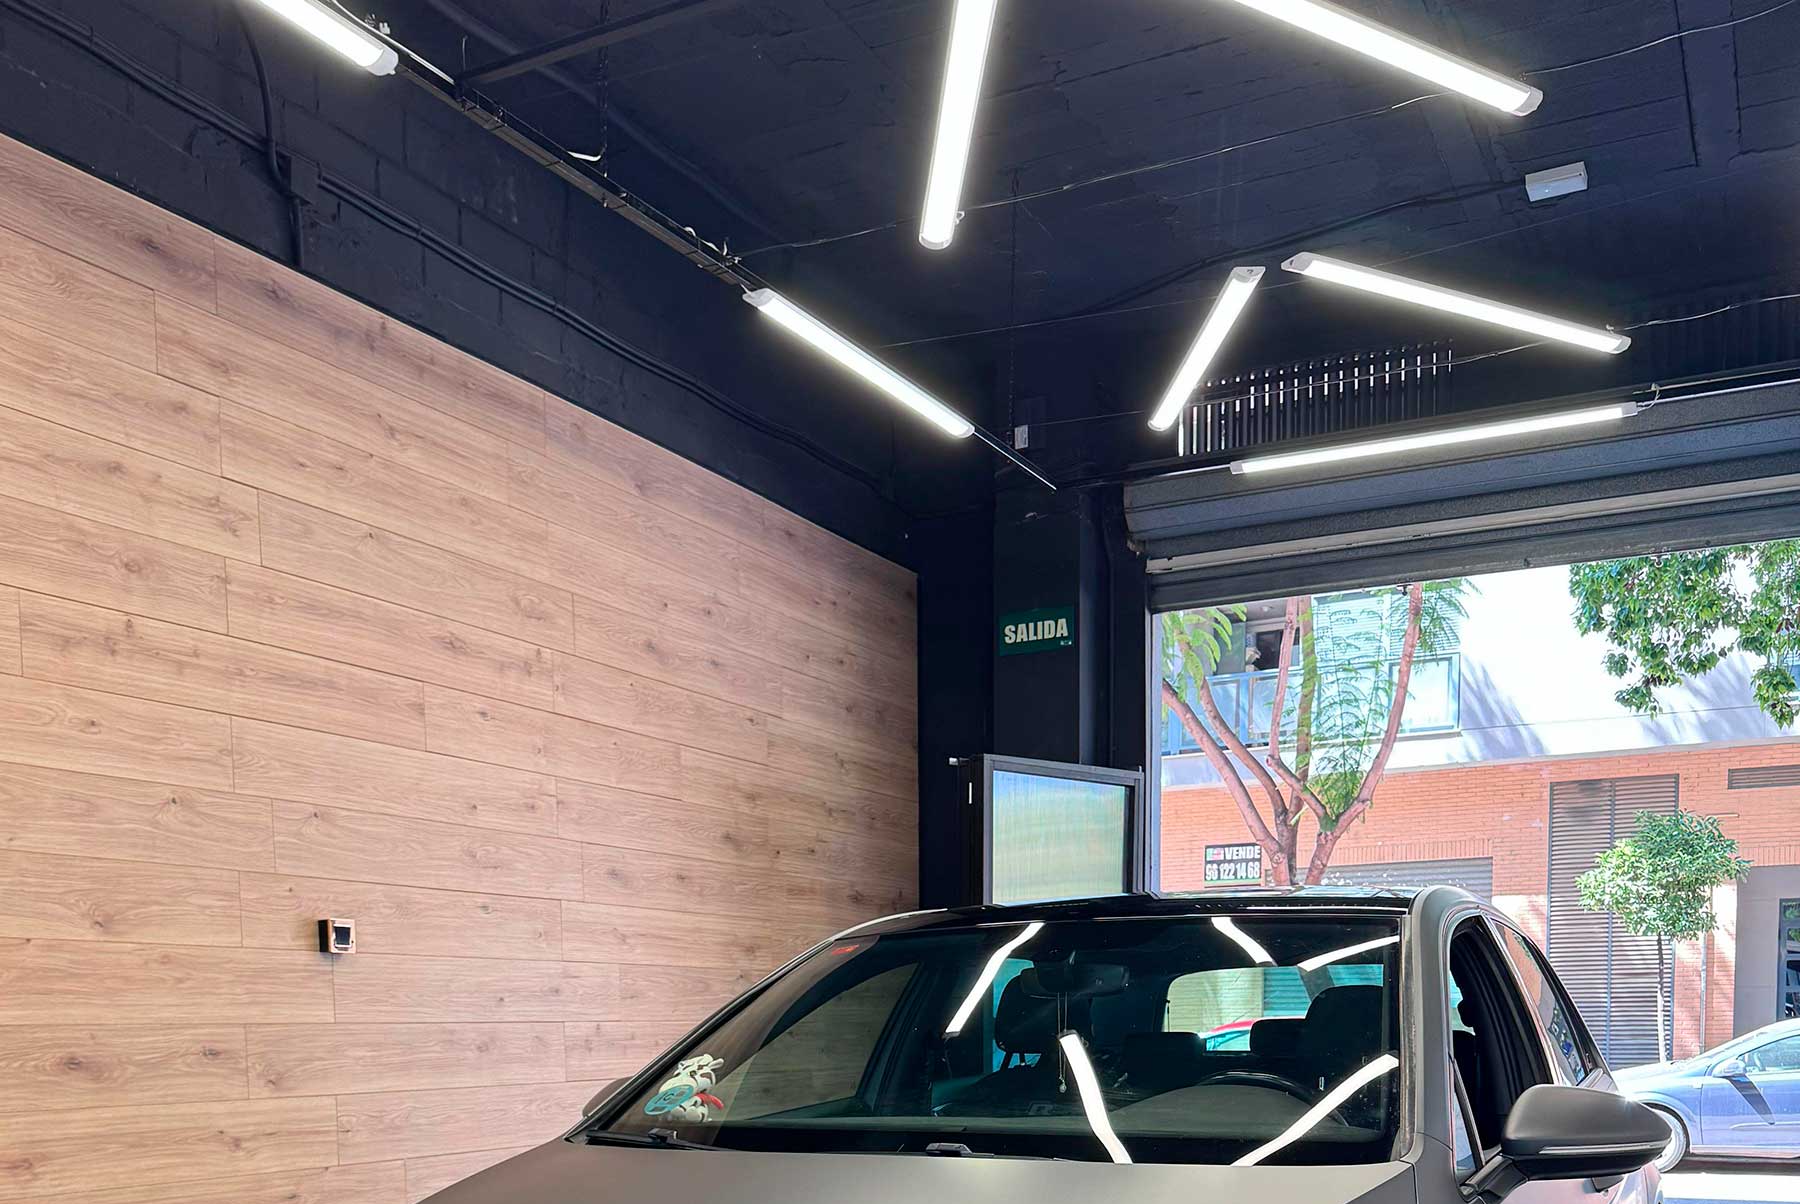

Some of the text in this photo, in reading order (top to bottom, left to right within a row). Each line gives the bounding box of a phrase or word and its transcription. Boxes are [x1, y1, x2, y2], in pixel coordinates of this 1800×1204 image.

[1004, 618, 1069, 644] SALIDA
[1225, 846, 1260, 860] VENDE
[1248, 861, 1260, 879] 68
